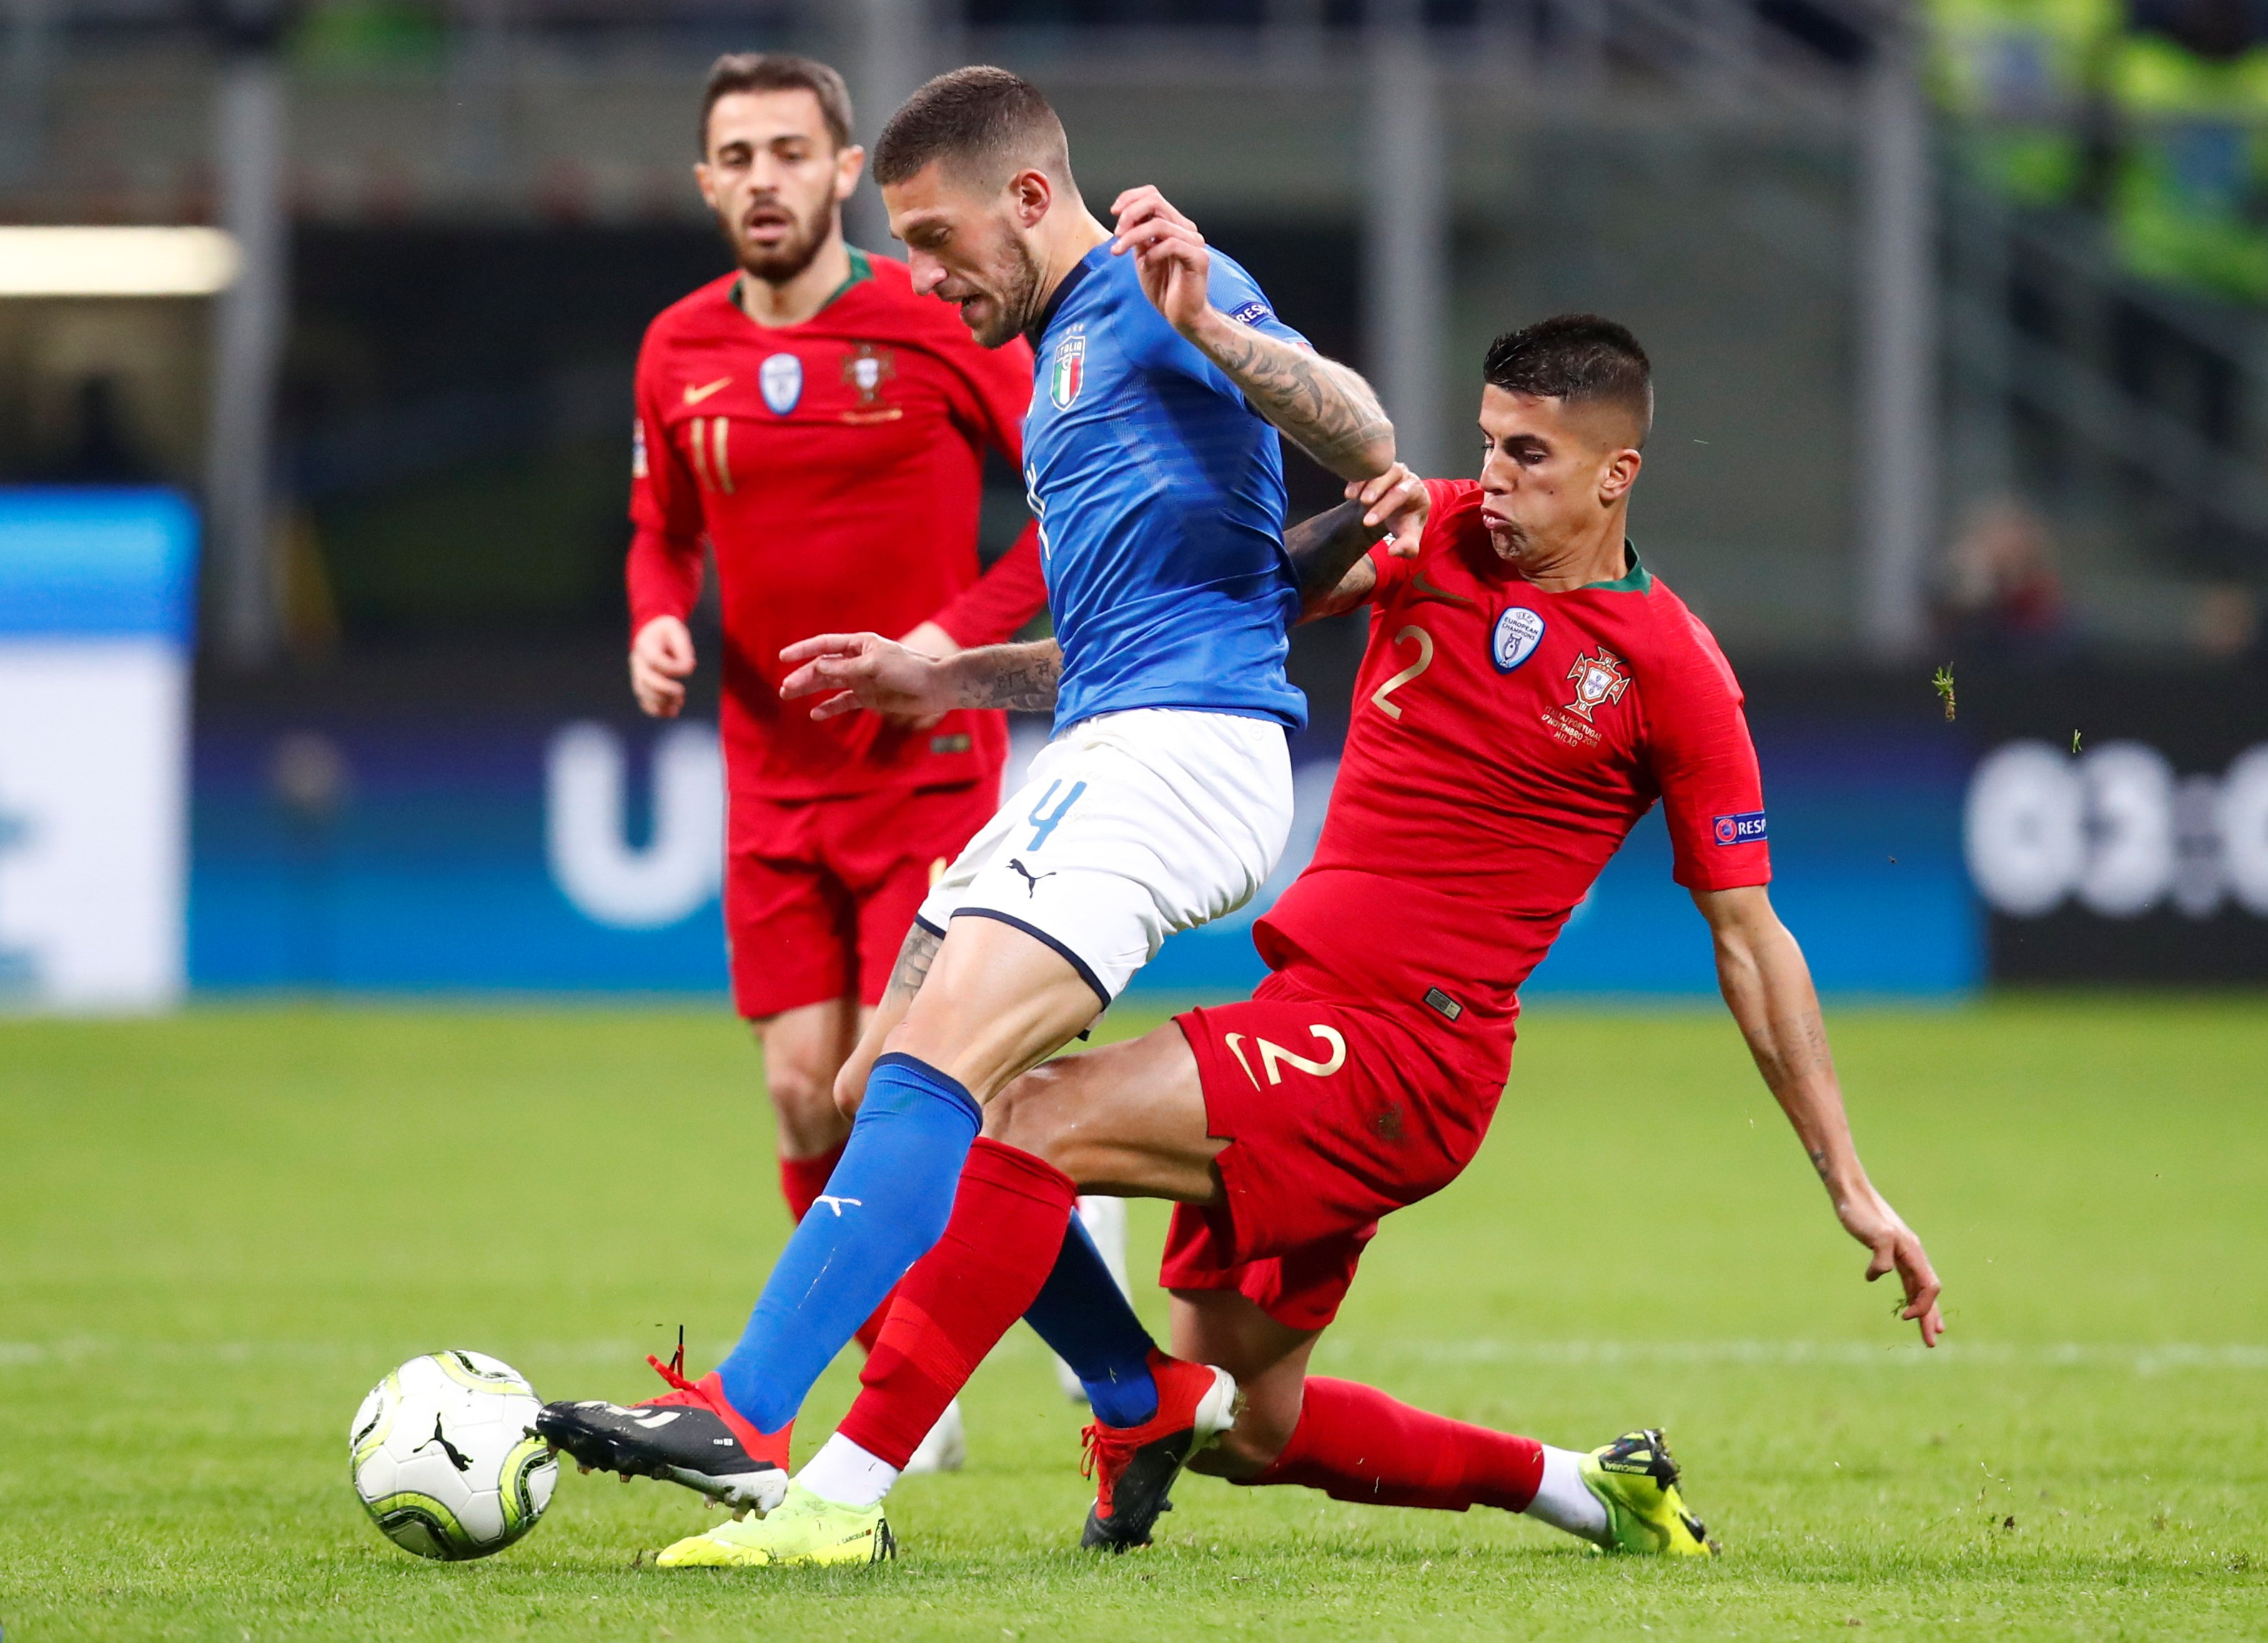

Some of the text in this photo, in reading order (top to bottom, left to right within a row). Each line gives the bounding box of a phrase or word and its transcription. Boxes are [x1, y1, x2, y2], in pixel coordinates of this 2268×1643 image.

[1057, 341, 1082, 358] ITALIA
[690, 416, 736, 495] 11
[1504, 616, 1539, 635] EUROPEAN
[1516, 613, 1534, 624] UEFA
[1502, 623, 1535, 641] CHAMPIONS
[1371, 624, 1433, 721] 2
[1547, 717, 1583, 741] NOVEMBRO
[1026, 779, 1087, 852] 4
[1256, 1024, 1347, 1086] 2
